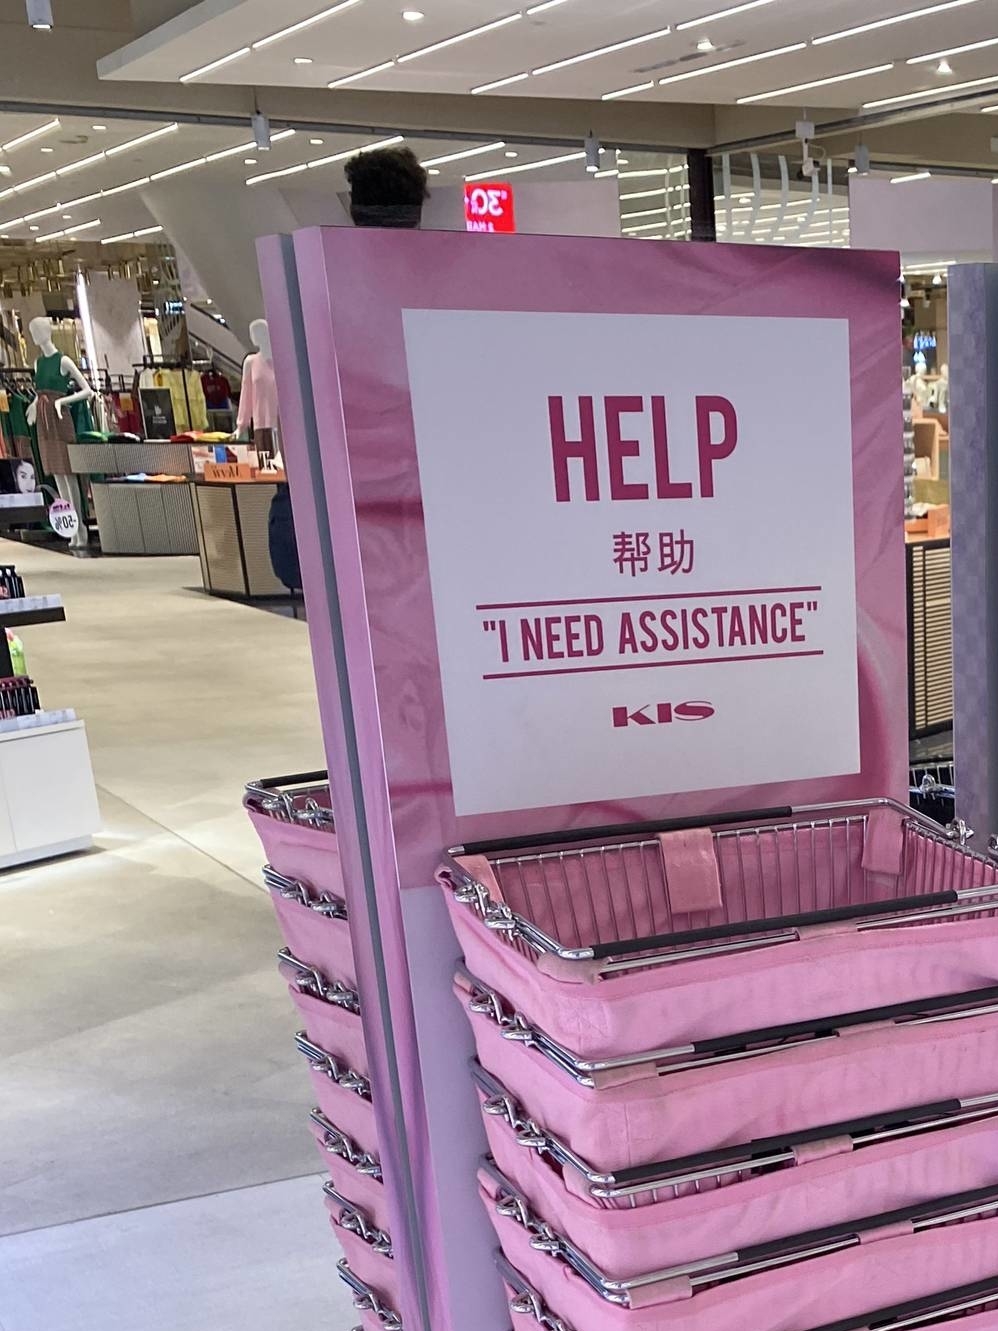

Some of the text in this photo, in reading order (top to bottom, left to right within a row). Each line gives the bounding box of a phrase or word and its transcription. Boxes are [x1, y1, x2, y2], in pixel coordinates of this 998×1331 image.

[548, 394, 739, 502] HELP
[612, 528, 696, 577] 帮助
[482, 600, 819, 663] "I NEED ASSISTANCE"
[612, 700, 716, 727] KIS
